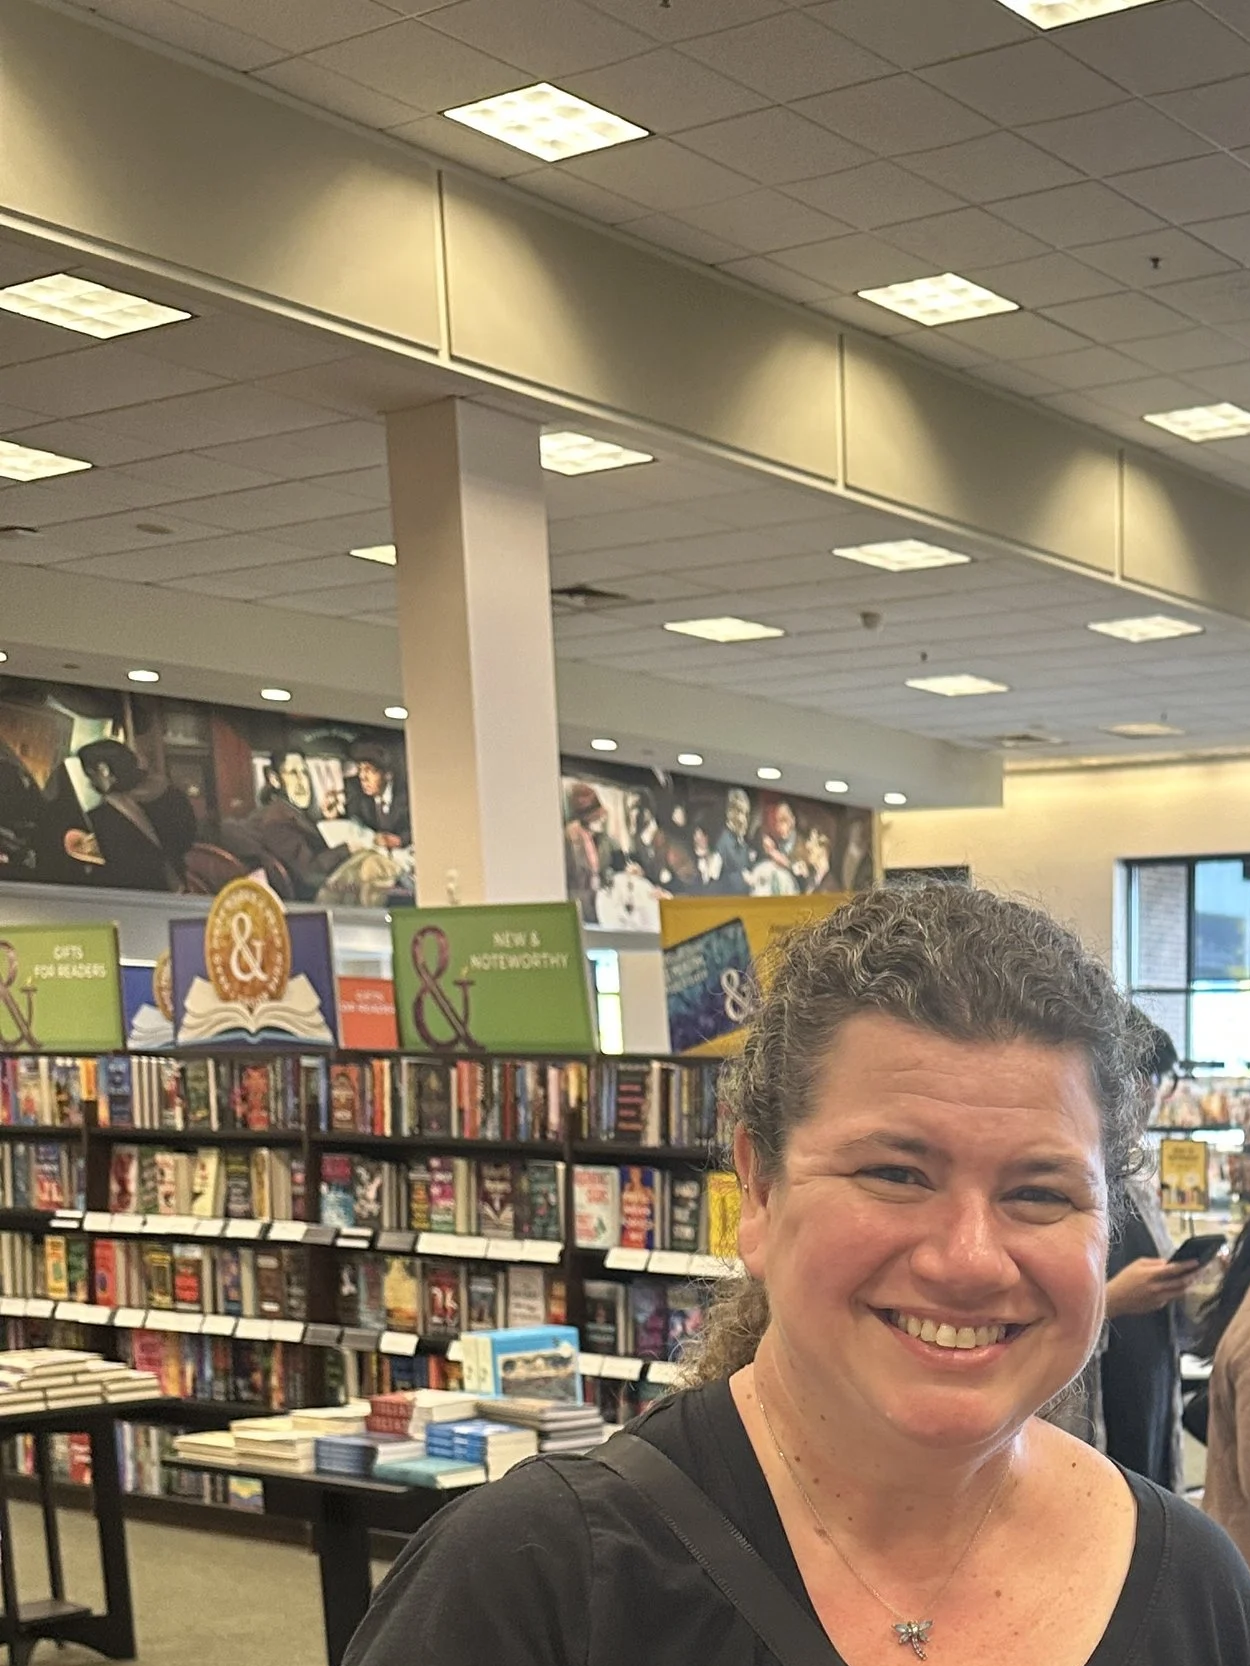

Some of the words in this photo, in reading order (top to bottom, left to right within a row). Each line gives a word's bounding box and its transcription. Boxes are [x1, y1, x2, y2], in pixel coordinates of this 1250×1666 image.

[492, 930, 526, 948] NEW
[530, 929, 541, 948] &
[53, 944, 83, 960] GIFTS
[469, 953, 569, 971] NOTEWORTHY
[34, 964, 55, 979] FOR
[57, 963, 106, 979] READERS
